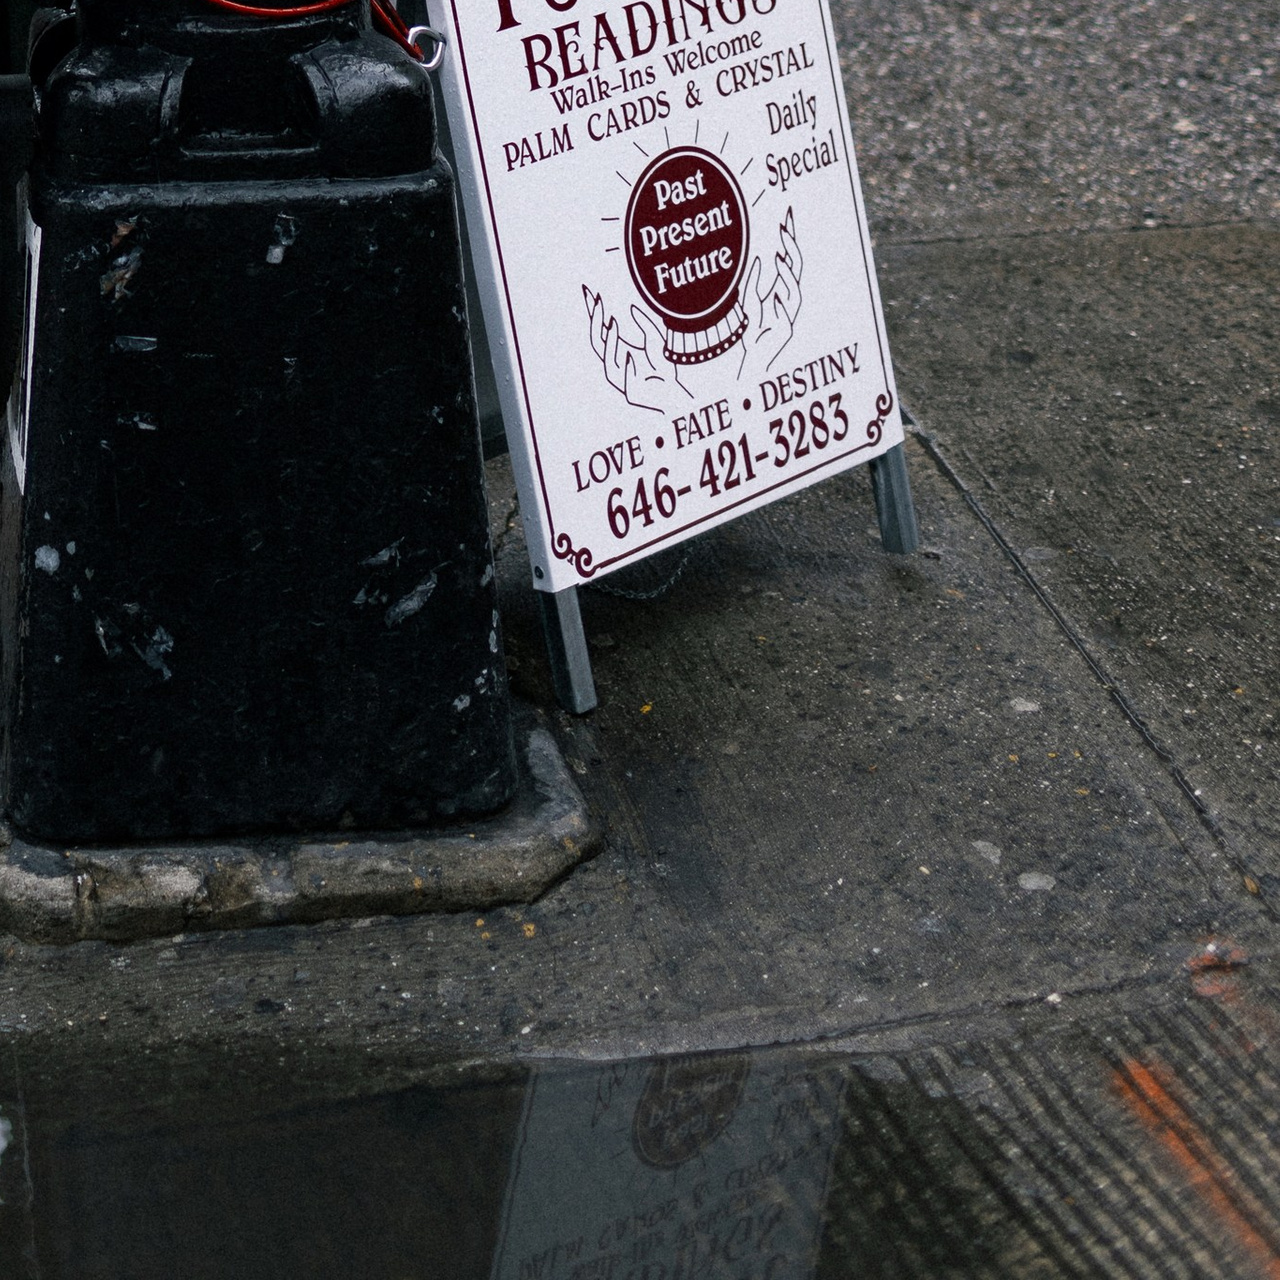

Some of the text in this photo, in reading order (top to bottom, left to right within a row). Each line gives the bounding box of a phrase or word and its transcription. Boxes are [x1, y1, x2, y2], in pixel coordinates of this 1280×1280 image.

[550, 30, 763, 115] Walk-Ins Welcome
[502, 42, 815, 172] PALM CARDS & CRYSTAL
[765, 90, 817, 135] Daily
[653, 169, 707, 210] Past
[765, 129, 839, 192] Special
[639, 200, 733, 256] Present
[654, 246, 733, 294] Future
[572, 342, 861, 492] LOVE FATE DESTINY
[607, 392, 849, 539] 646-421-3283
